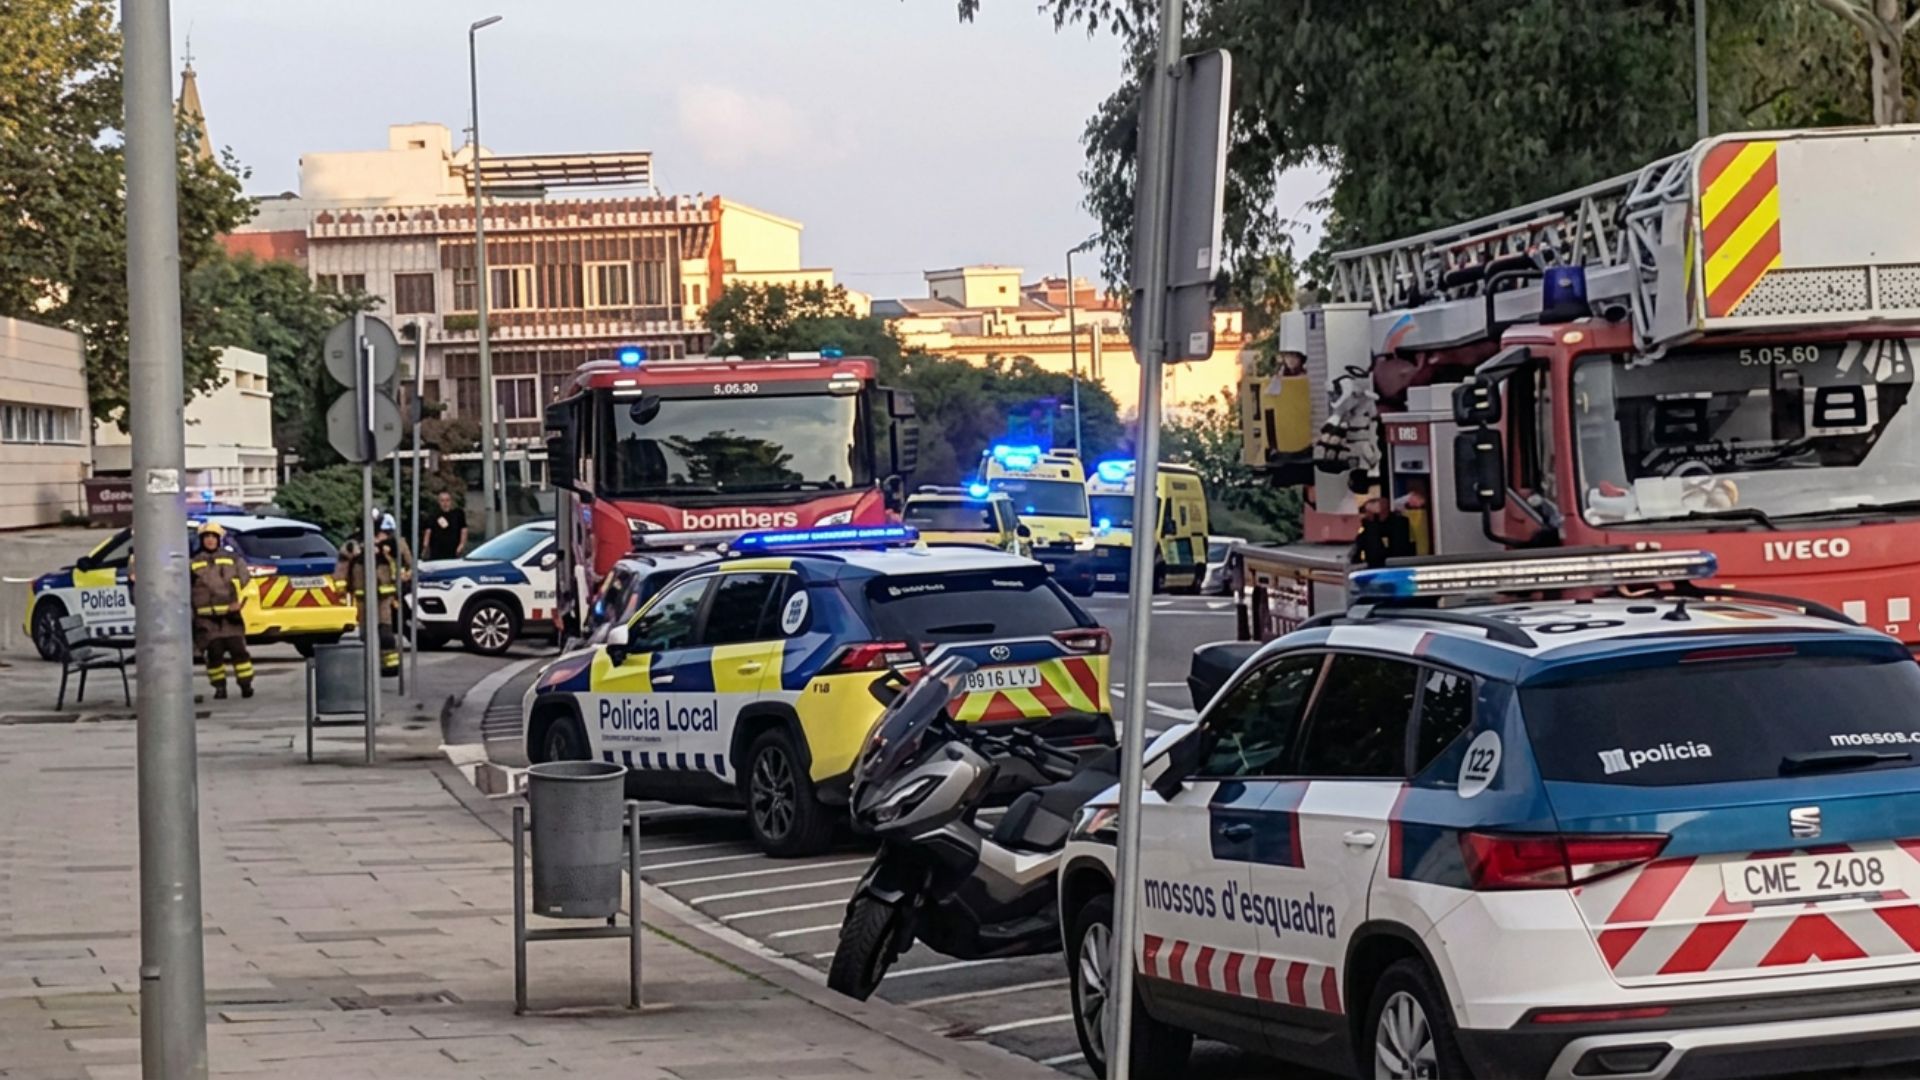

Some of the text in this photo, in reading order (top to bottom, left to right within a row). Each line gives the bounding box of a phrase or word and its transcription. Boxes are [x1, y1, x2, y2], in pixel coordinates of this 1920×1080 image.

[1739, 345, 1820, 366] 5.05.60
[682, 508, 799, 530] bombers
[1764, 538, 1850, 562] IVECO
[967, 667, 1037, 688] 8916 LYJ
[599, 698, 718, 732] Policia Local
[1467, 747, 1496, 773] 122
[1629, 741, 1712, 769] policia
[1743, 857, 1885, 895] CME 2408
[1144, 878, 1337, 940] mossos d'esquadra
